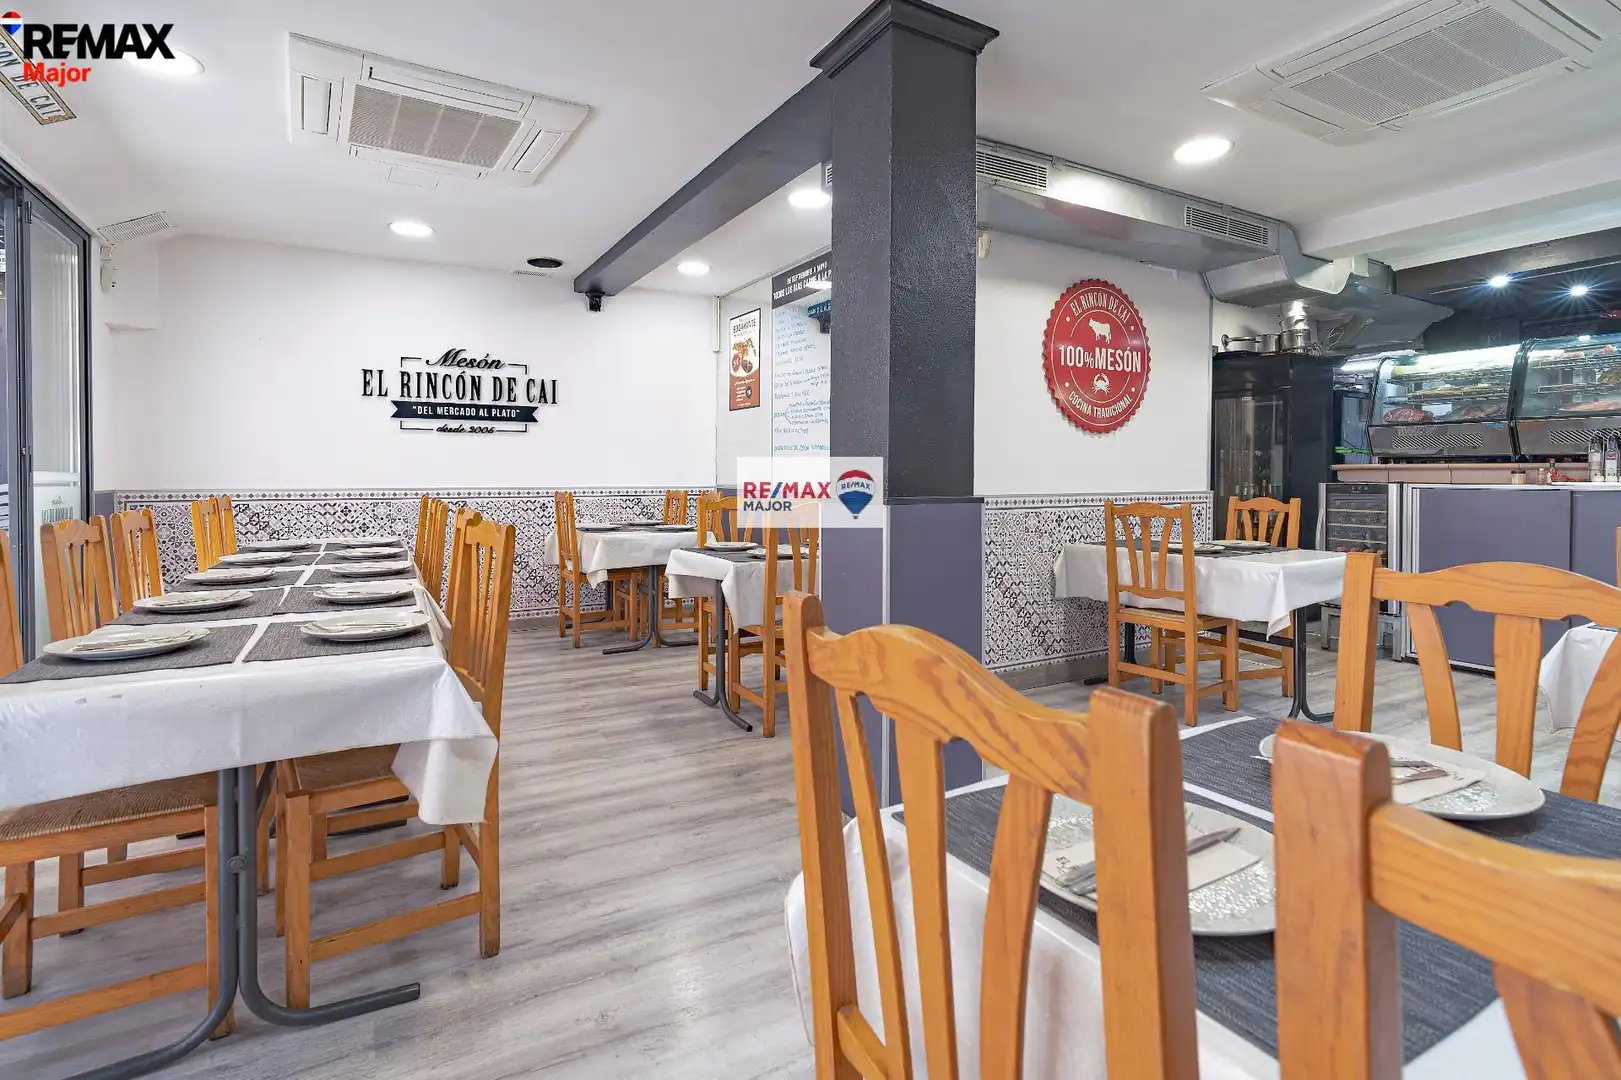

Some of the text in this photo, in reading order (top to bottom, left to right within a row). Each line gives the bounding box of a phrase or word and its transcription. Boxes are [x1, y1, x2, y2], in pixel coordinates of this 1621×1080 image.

[30, 95, 61, 115] CAI
[1070, 291, 1131, 323] EL RINCÓN DE CAI
[425, 348, 506, 370] Mesón
[361, 369, 558, 404] EL RINCÓN DE CAI
[436, 406, 476, 416] MERCADO
[479, 408, 489, 417] AL
[1069, 391, 1132, 418] COCINA TRADICIONAL
[436, 424, 466, 433] desde
